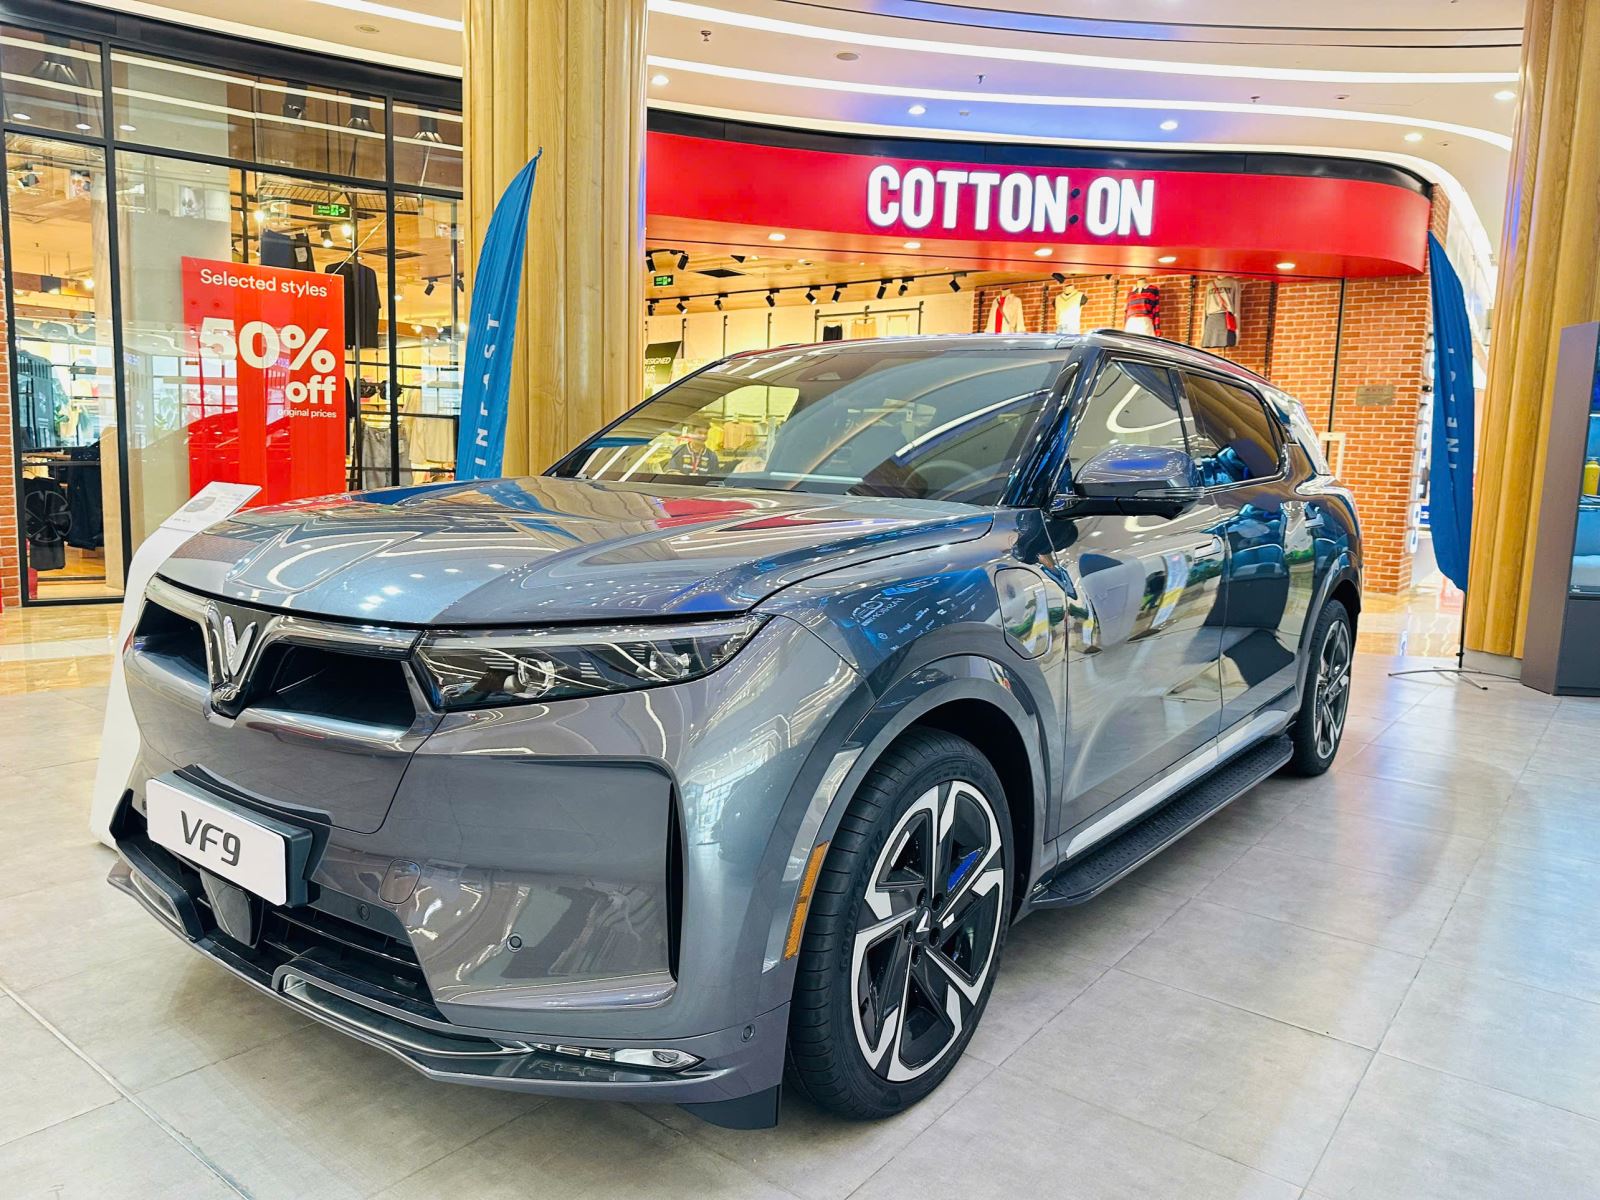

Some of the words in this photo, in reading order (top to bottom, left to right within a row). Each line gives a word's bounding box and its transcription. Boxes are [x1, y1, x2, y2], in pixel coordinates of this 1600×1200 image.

[200, 268, 277, 292] Selected
[281, 280, 328, 298] styles
[199, 317, 336, 374] 50%
[285, 375, 337, 405] off
[474, 313, 500, 480] INFAST
[277, 408, 310, 418] original
[311, 409, 337, 419] prices
[180, 810, 241, 867] VF9
